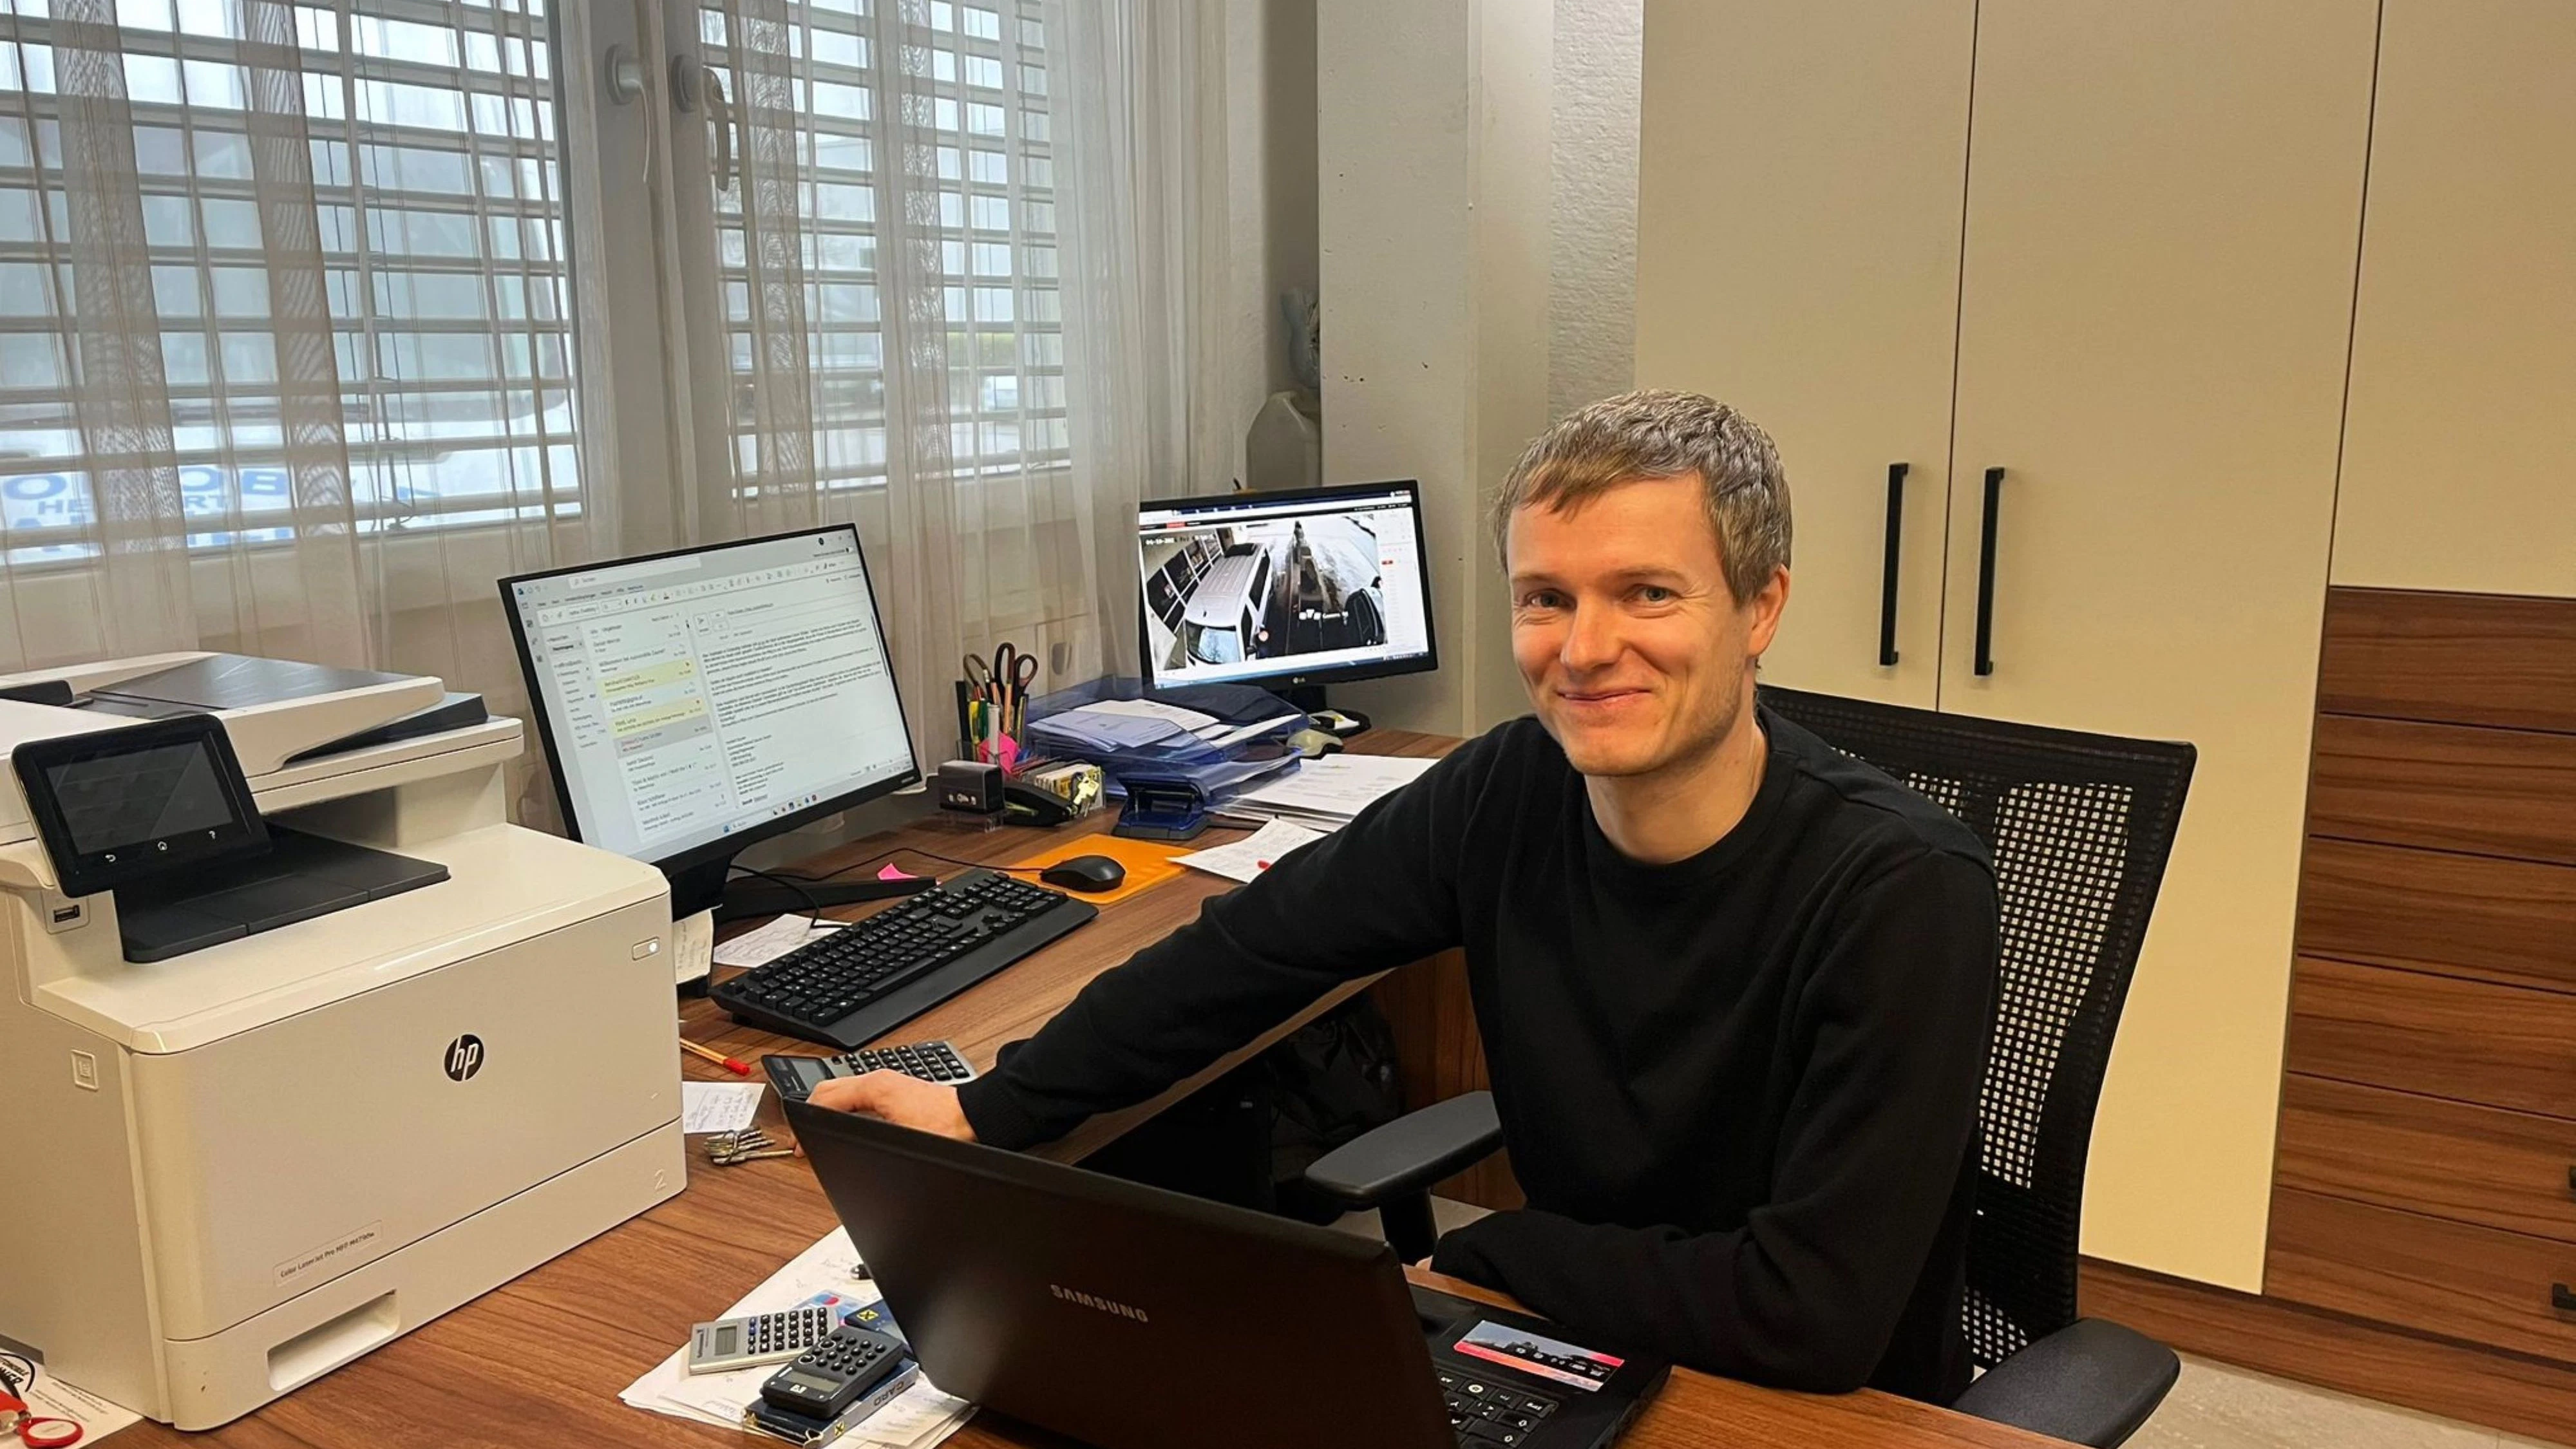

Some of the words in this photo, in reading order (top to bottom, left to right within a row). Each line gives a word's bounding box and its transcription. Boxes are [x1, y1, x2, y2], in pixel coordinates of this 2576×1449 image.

[450, 1035, 480, 1081] hp
[654, 1168, 668, 1191] 2
[1050, 1284, 1149, 1323] SAMSUNG
[873, 1381, 905, 1406] CARD
